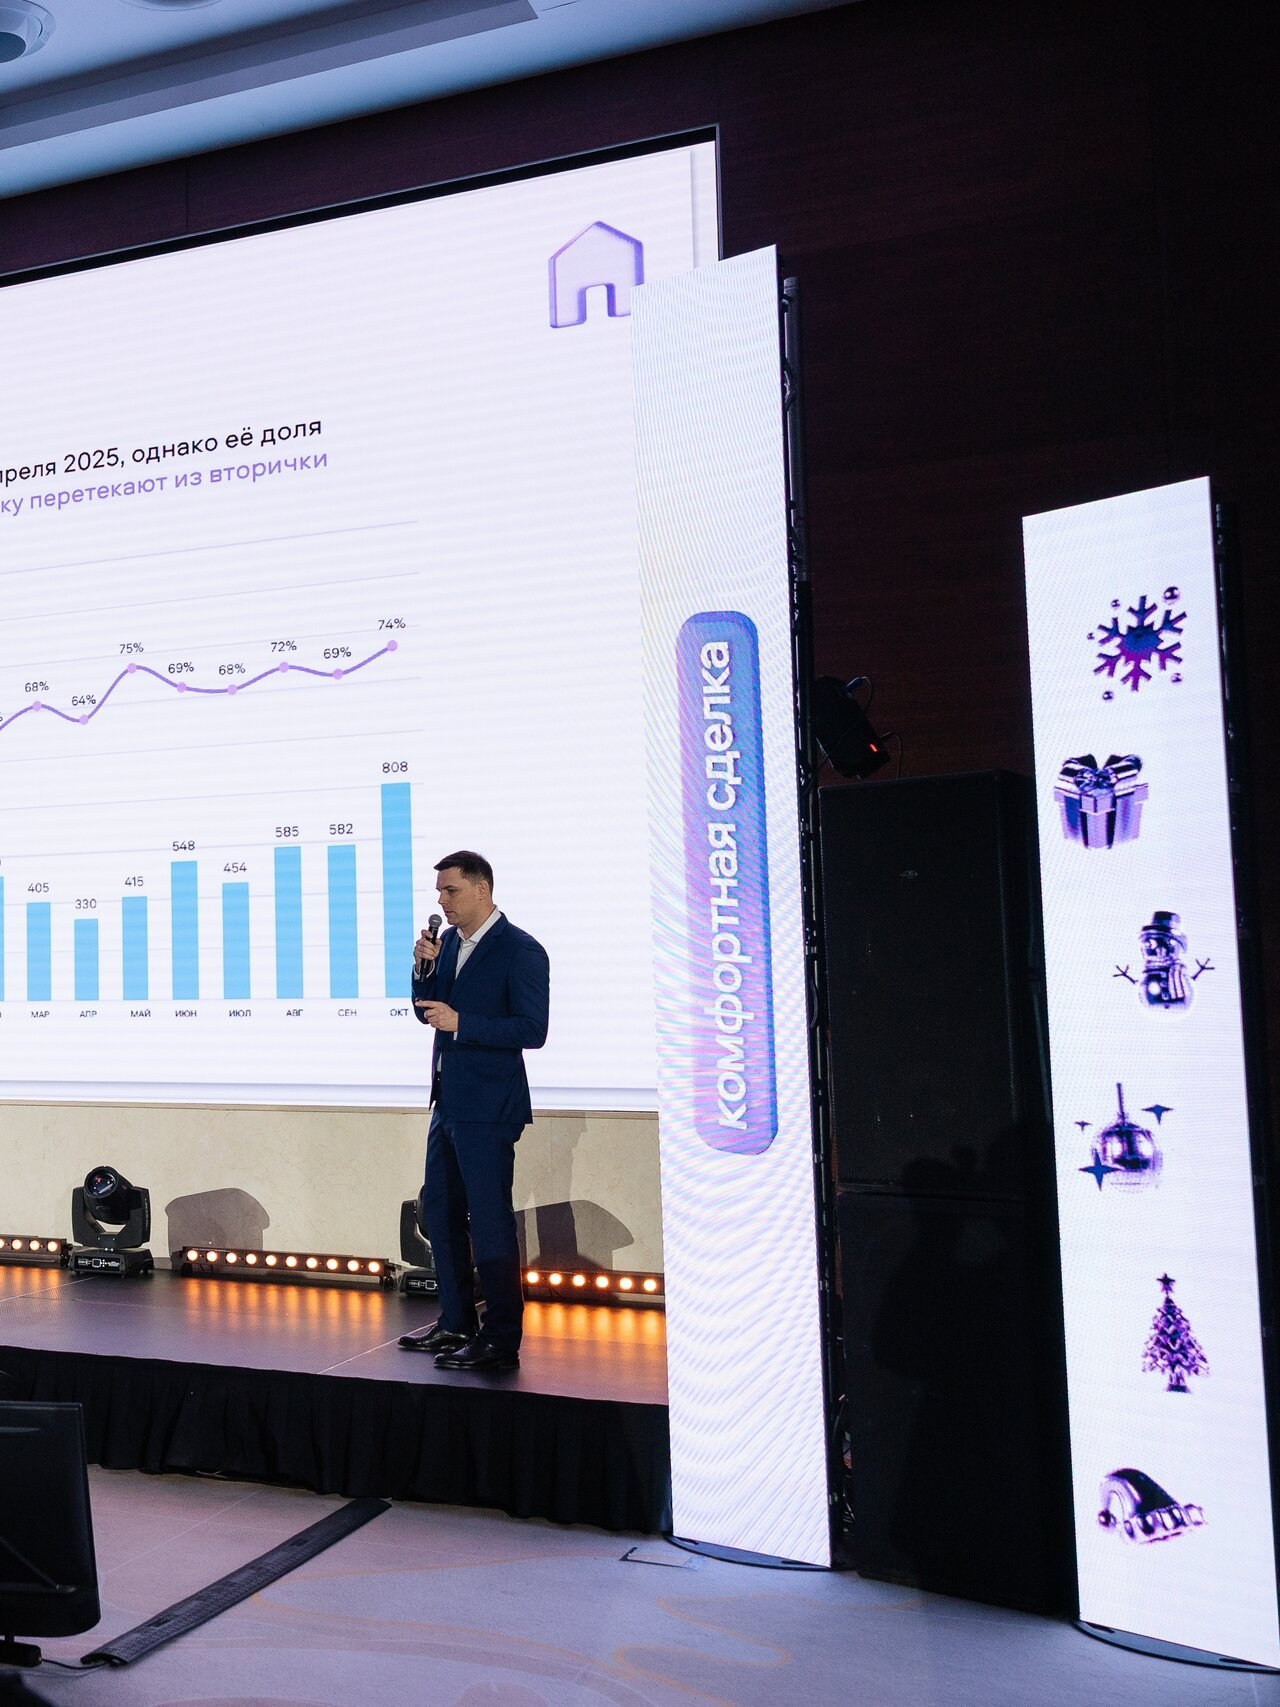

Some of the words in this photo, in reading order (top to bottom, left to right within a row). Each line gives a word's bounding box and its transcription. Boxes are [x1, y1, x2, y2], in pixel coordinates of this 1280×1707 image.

[63, 446, 125, 474] 2025,
[131, 437, 219, 465] однако
[224, 426, 254, 449] её
[260, 420, 322, 448] доля
[30, 476, 168, 511] перетекают
[174, 471, 202, 489] из
[209, 453, 328, 484] вторички
[377, 617, 407, 631] 74%
[119, 642, 145, 655] 75%
[270, 640, 298, 653] 72%
[323, 646, 352, 660] 69%
[167, 661, 195, 675] 69%
[218, 663, 246, 676] 68%
[24, 680, 50, 693] 68%
[70, 694, 97, 707] 64%
[700, 641, 742, 811] сделка
[381, 760, 410, 774] 808
[275, 825, 300, 838] 585
[329, 822, 354, 836] 582
[172, 839, 196, 852] 548
[223, 862, 248, 874] 454
[124, 875, 144, 887] 415
[27, 882, 50, 894] 405
[74, 898, 97, 910] 330
[703, 822, 755, 1130] комфортная
[31, 1010, 50, 1019] МАР
[79, 1010, 98, 1018] АПР
[130, 1008, 152, 1018] МАЙ
[174, 1009, 198, 1018] ИЮН
[228, 1009, 252, 1018] ИЮЛ
[285, 1008, 304, 1017] АВГ
[337, 1008, 358, 1017] СЕН
[389, 1008, 409, 1017] ОКТ
